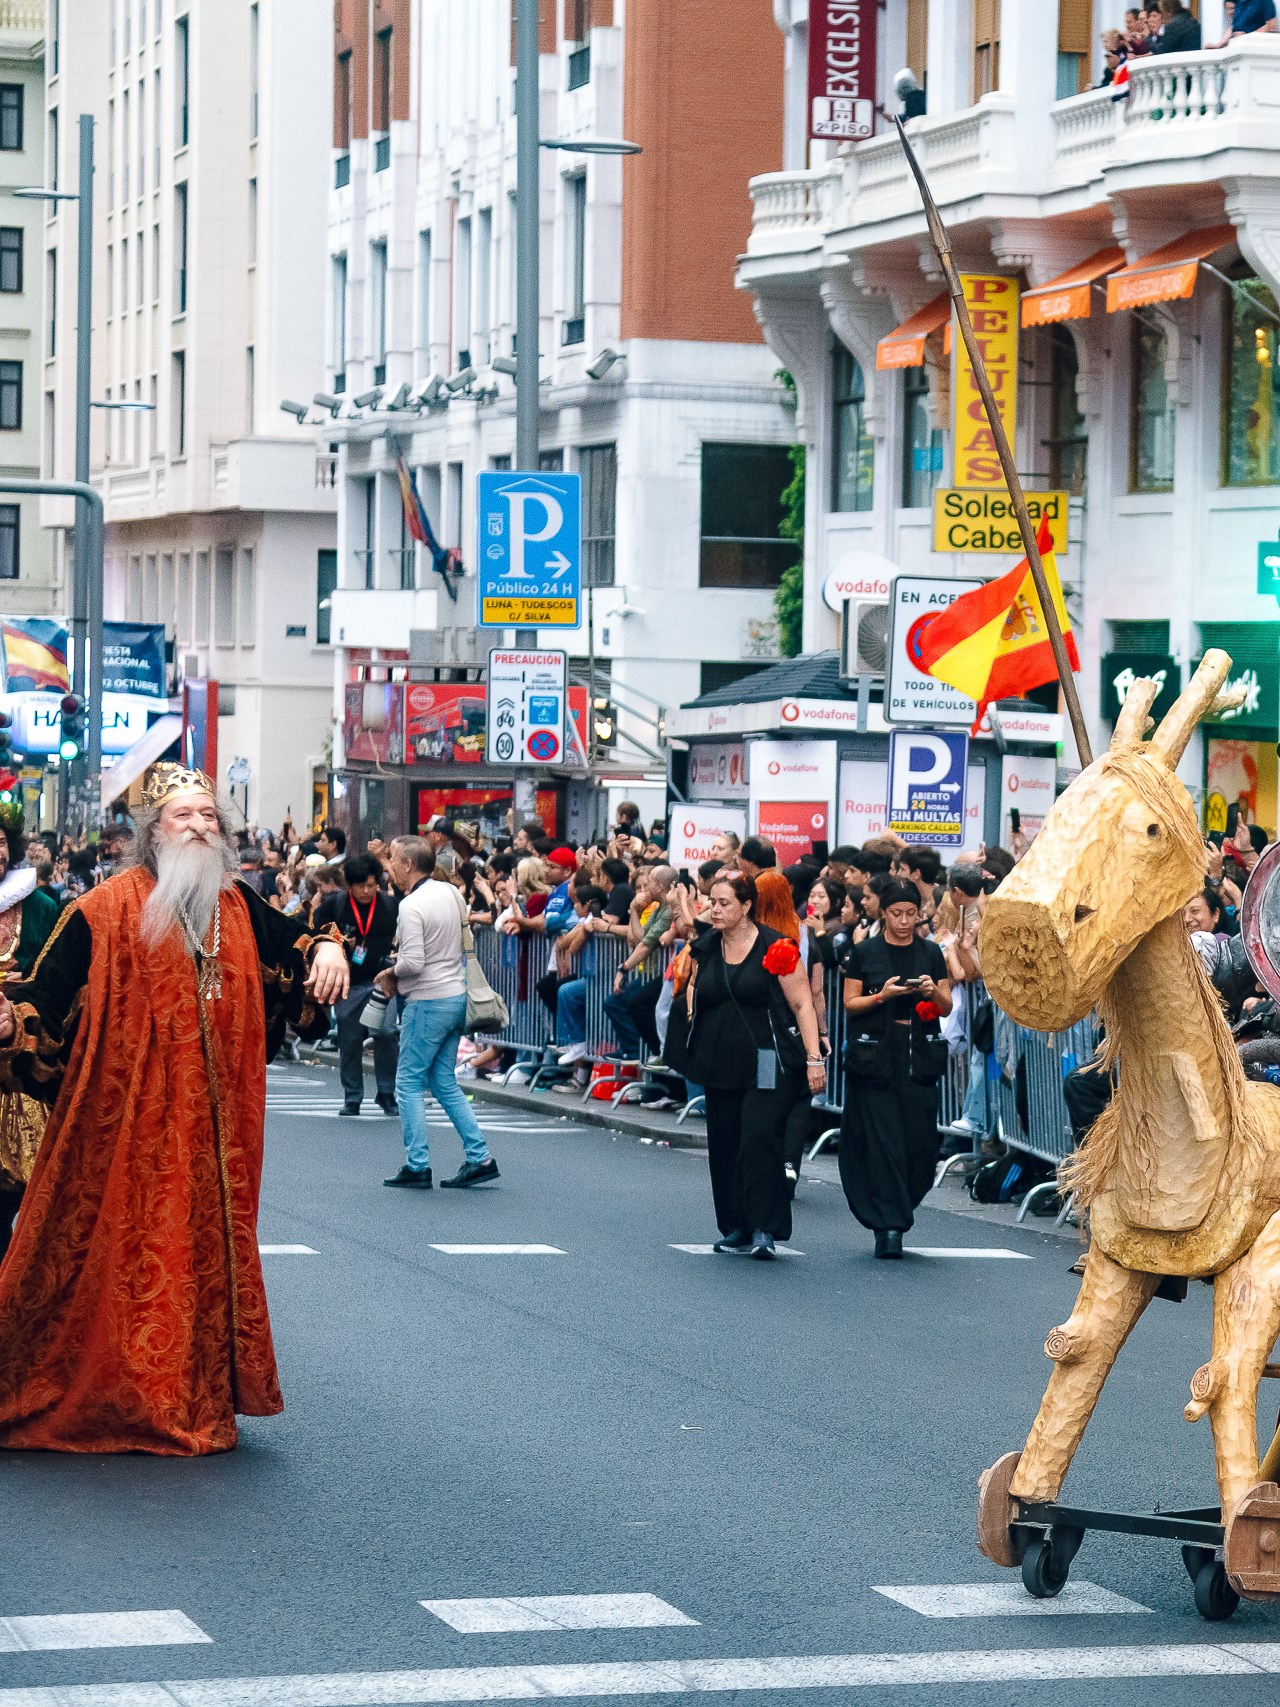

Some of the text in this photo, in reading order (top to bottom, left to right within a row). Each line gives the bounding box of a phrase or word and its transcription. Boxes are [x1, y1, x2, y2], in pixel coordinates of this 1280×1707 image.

[826, 0, 861, 97] EXCELSI
[965, 278, 1008, 482] PELUCAS
[499, 491, 564, 578] P
[486, 582, 573, 595] Público 24 H
[836, 579, 888, 594] vodafo
[902, 592, 959, 605] EN ACE
[486, 600, 513, 609] LUNA
[522, 600, 573, 610] TUDESCOS
[525, 612, 551, 621] SILVA
[494, 653, 561, 665] PRECAUCIÓN
[114, 678, 159, 694] OCTUBRE
[904, 681, 934, 691] TODO
[893, 699, 974, 710] DE VEHÍCULOS
[803, 708, 857, 721] vodafone
[1000, 719, 1050, 732] vodafone
[499, 738, 511, 753] 30
[783, 764, 819, 773] vodafone
[892, 734, 952, 810] P
[911, 791, 951, 801] ABIERTO
[845, 799, 887, 814] Roam
[911, 800, 926, 811] 24
[890, 811, 961, 823] SIN MULTAS
[760, 823, 800, 833] Vodafone
[890, 823, 960, 832] PARKING CALLAO
[776, 834, 810, 846] Prepago
[899, 833, 959, 843] UDESCOS 3
